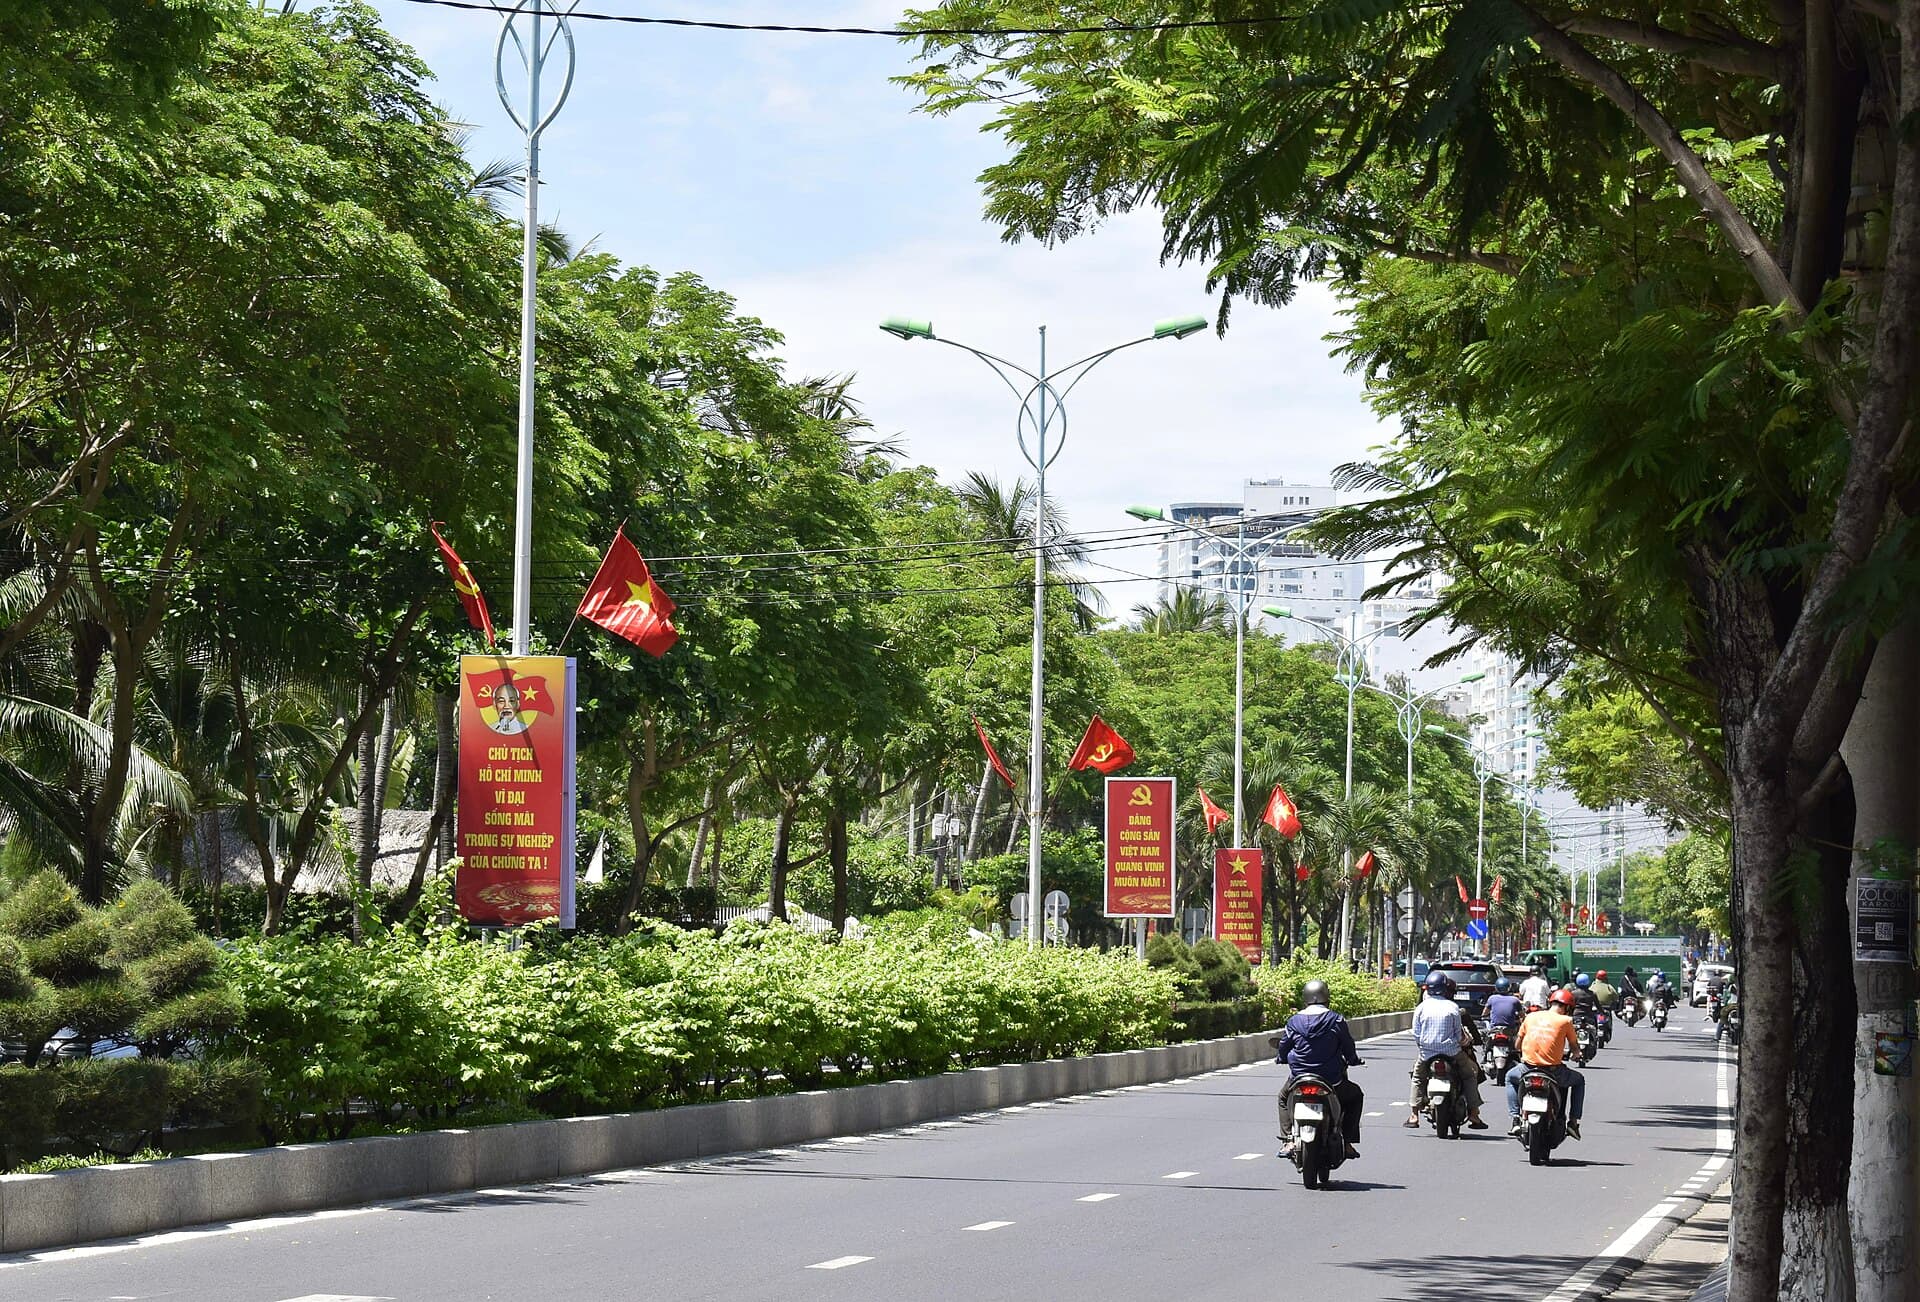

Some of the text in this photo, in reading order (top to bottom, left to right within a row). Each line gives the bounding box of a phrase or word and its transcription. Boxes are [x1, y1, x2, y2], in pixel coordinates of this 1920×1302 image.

[488, 743, 533, 763] CHỦ TỊCH
[479, 764, 543, 783] HỒ CHÍ MINH
[508, 791, 525, 807] ĐẠI
[485, 807, 512, 826] SỐNG
[464, 832, 555, 851] TRONG SỰ NGHIỆP
[1120, 829, 1142, 843] CỘNG
[1120, 845, 1160, 858] VIỆT NAM
[470, 851, 489, 868] CỦA
[492, 853, 525, 869] CHÚNG
[528, 856, 541, 870] TA
[1115, 861, 1165, 873] QUANG VINH
[1114, 875, 1139, 887] MUÔN
[1238, 922, 1254, 930] NAM
